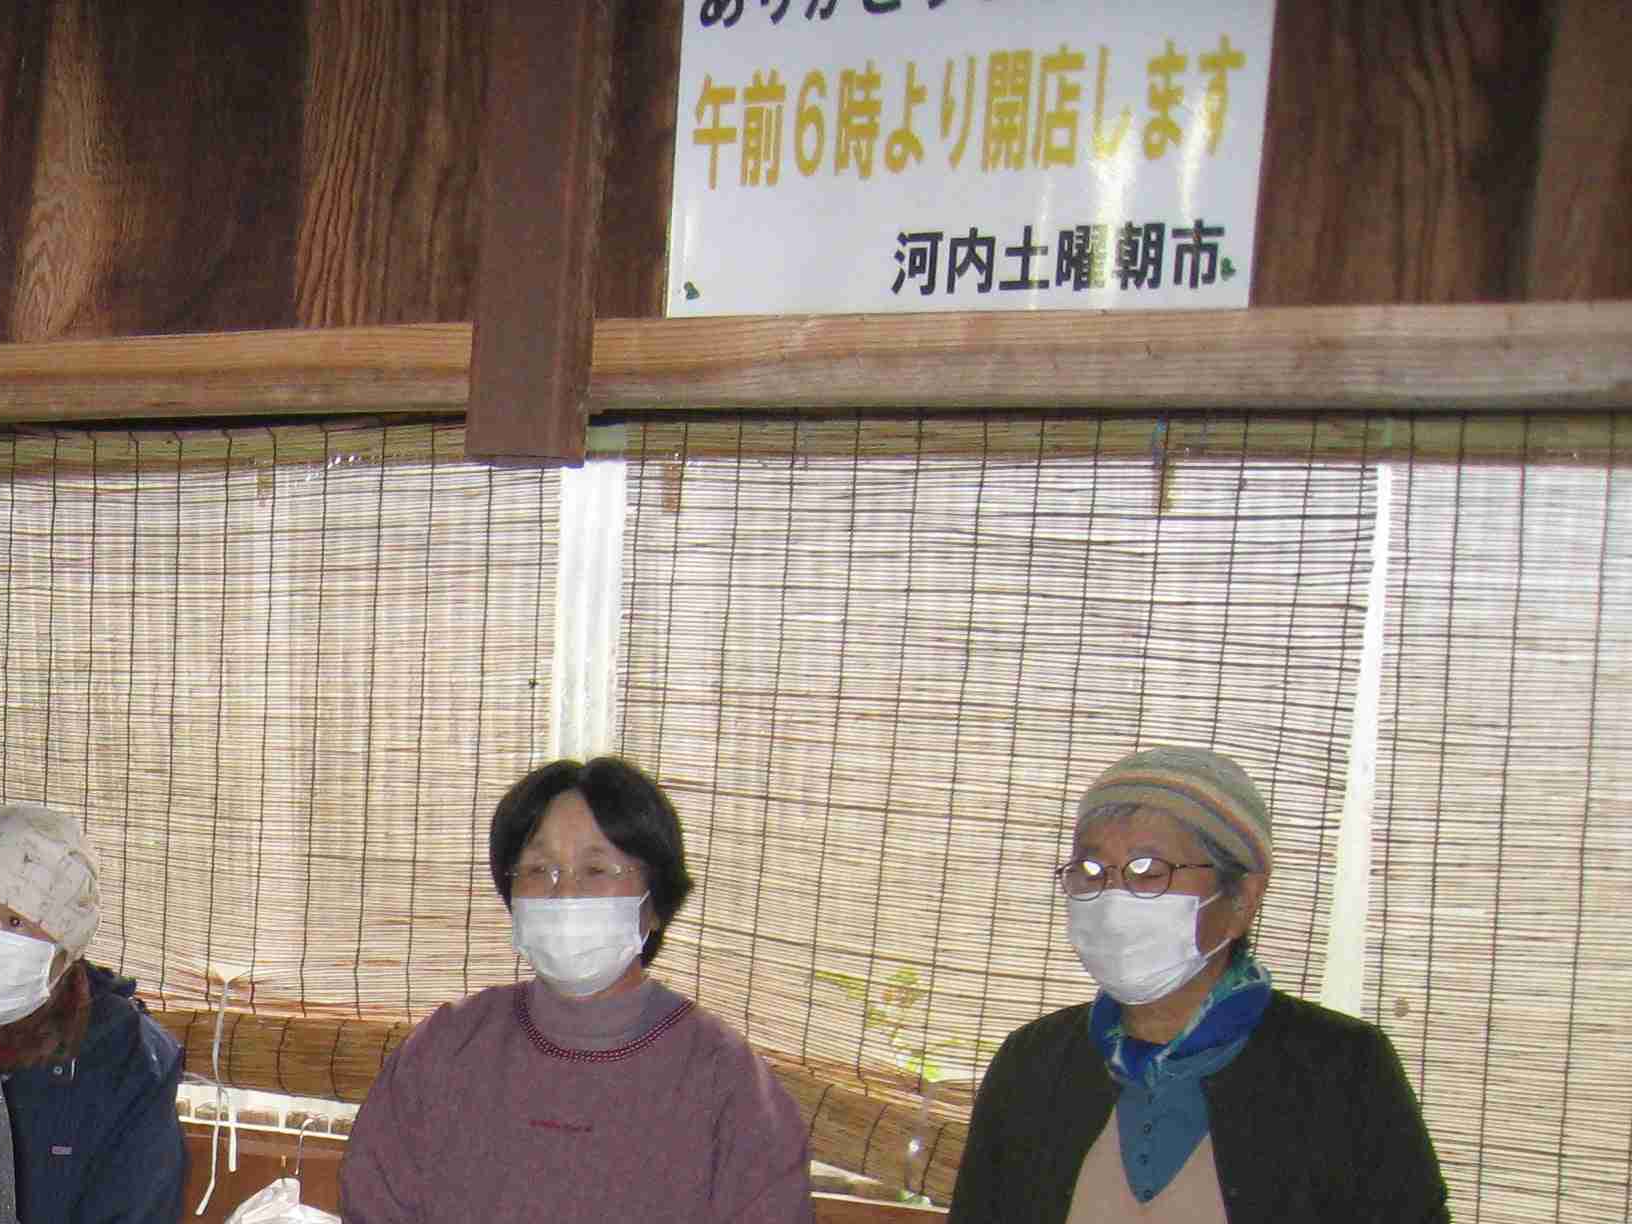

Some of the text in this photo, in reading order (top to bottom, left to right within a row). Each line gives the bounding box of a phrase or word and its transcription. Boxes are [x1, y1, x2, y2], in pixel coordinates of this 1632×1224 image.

[692, 35, 1246, 190] 午前6時より開店します
[892, 220, 1225, 295] 河内土曜朝市
